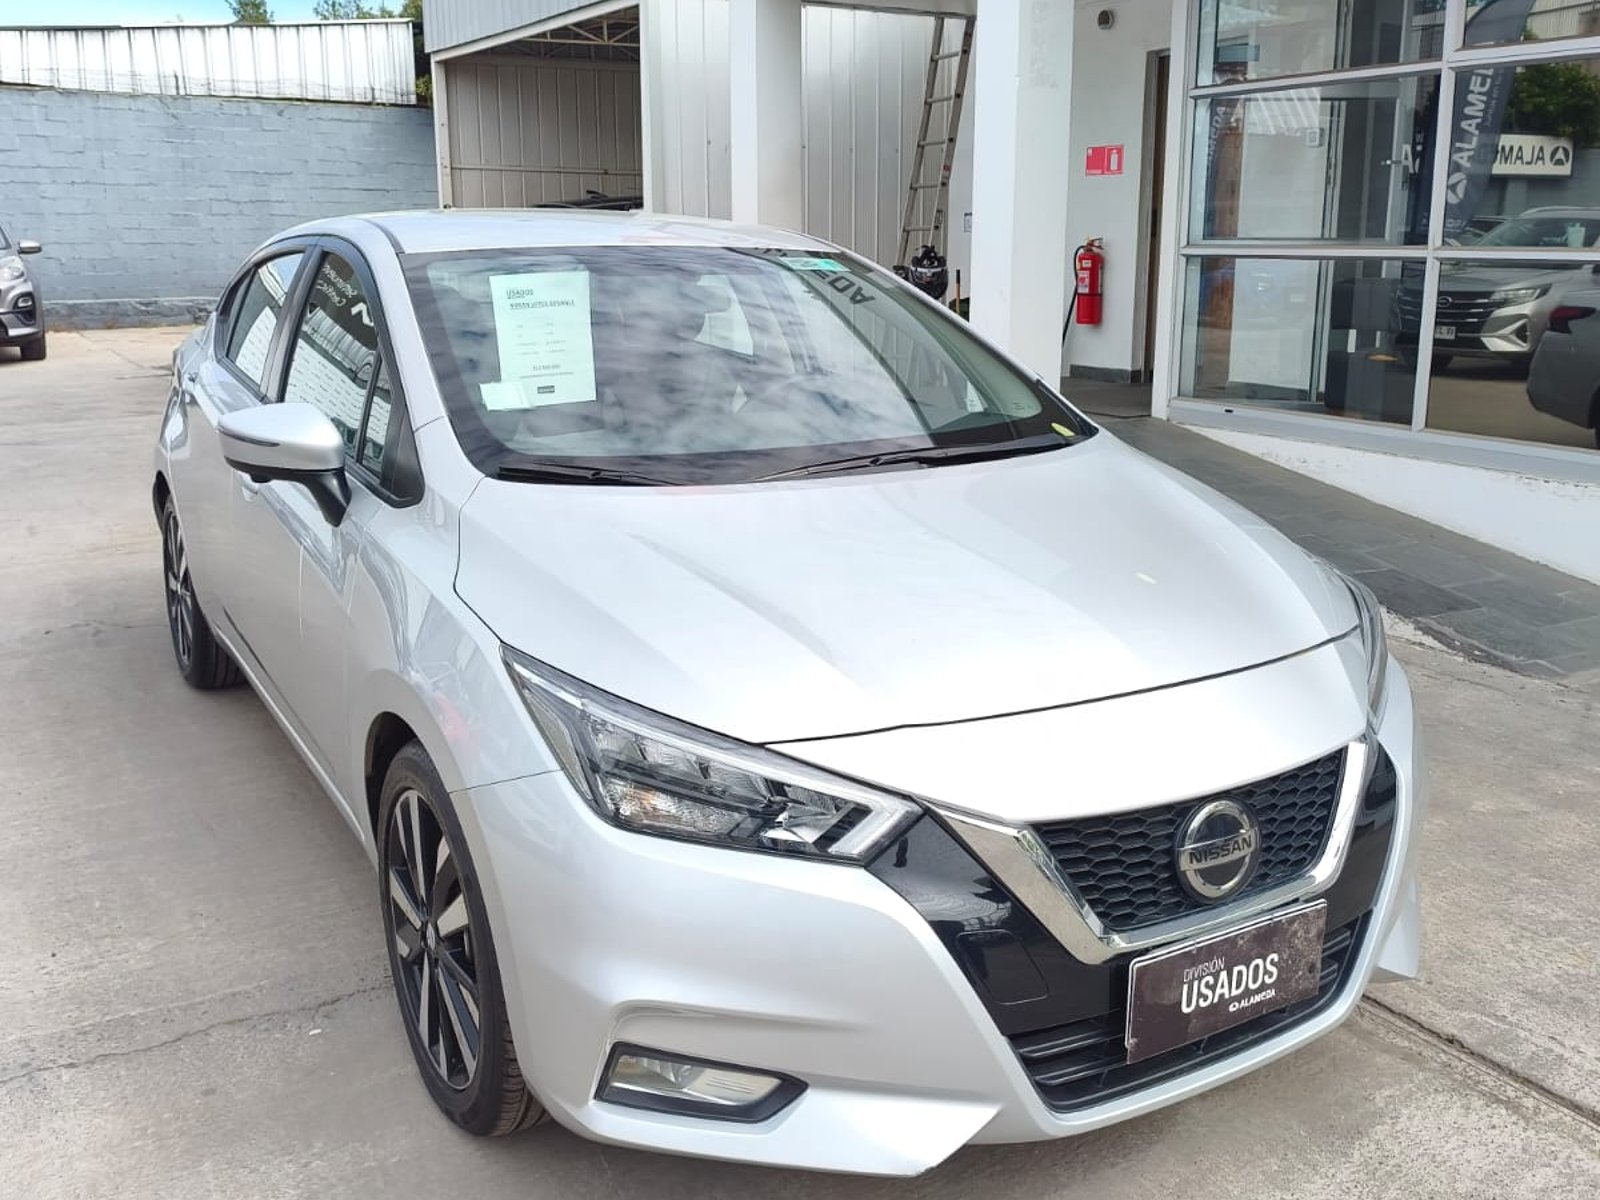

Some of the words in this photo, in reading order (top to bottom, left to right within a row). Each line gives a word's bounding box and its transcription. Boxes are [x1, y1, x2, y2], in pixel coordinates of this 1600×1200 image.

[1452, 68, 1494, 168] ALAME
[1188, 833, 1254, 865] NISSAN
[1181, 952, 1280, 1014] USADOS
[1183, 954, 1225, 982] DIVISIÓN
[1239, 988, 1277, 1008] ALAMEDA
